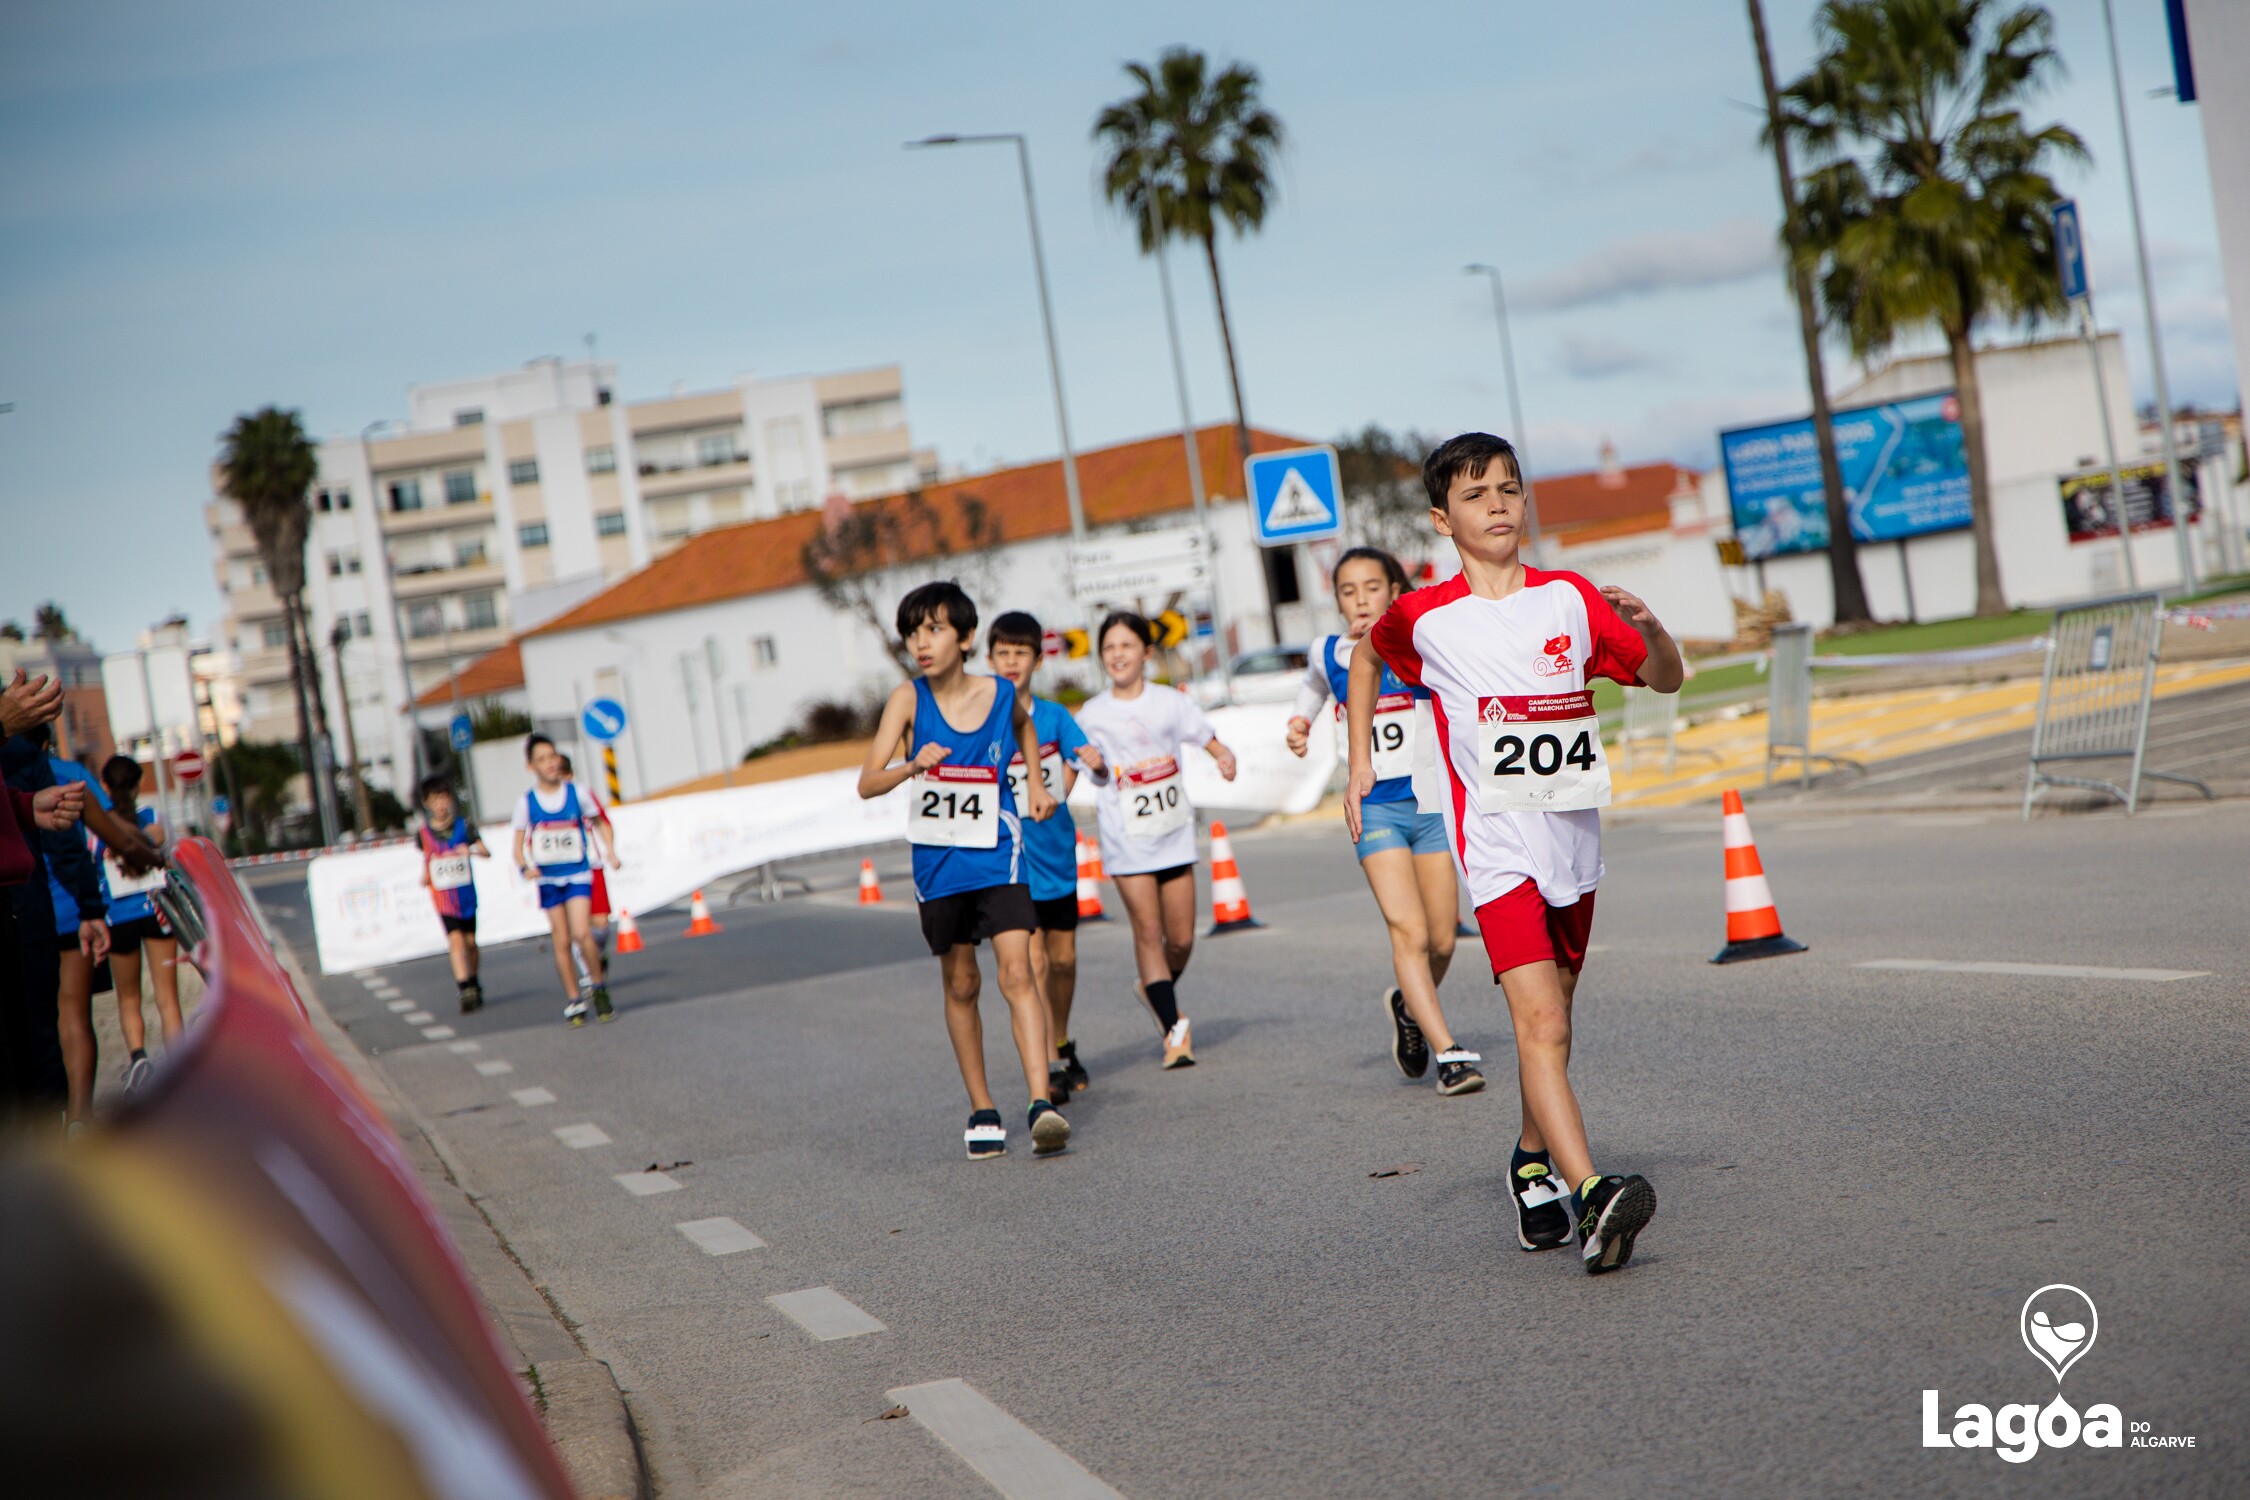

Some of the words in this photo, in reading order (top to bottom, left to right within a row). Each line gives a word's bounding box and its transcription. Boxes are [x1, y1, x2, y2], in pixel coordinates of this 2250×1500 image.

[2058, 209, 2079, 290] P
[1528, 697, 1569, 706] CAMPEONATO
[1538, 703, 1564, 712] MARCHA
[1372, 722, 1404, 752] 19
[1493, 731, 1597, 776] 204
[921, 791, 983, 820] 214
[1135, 786, 1177, 816] 210
